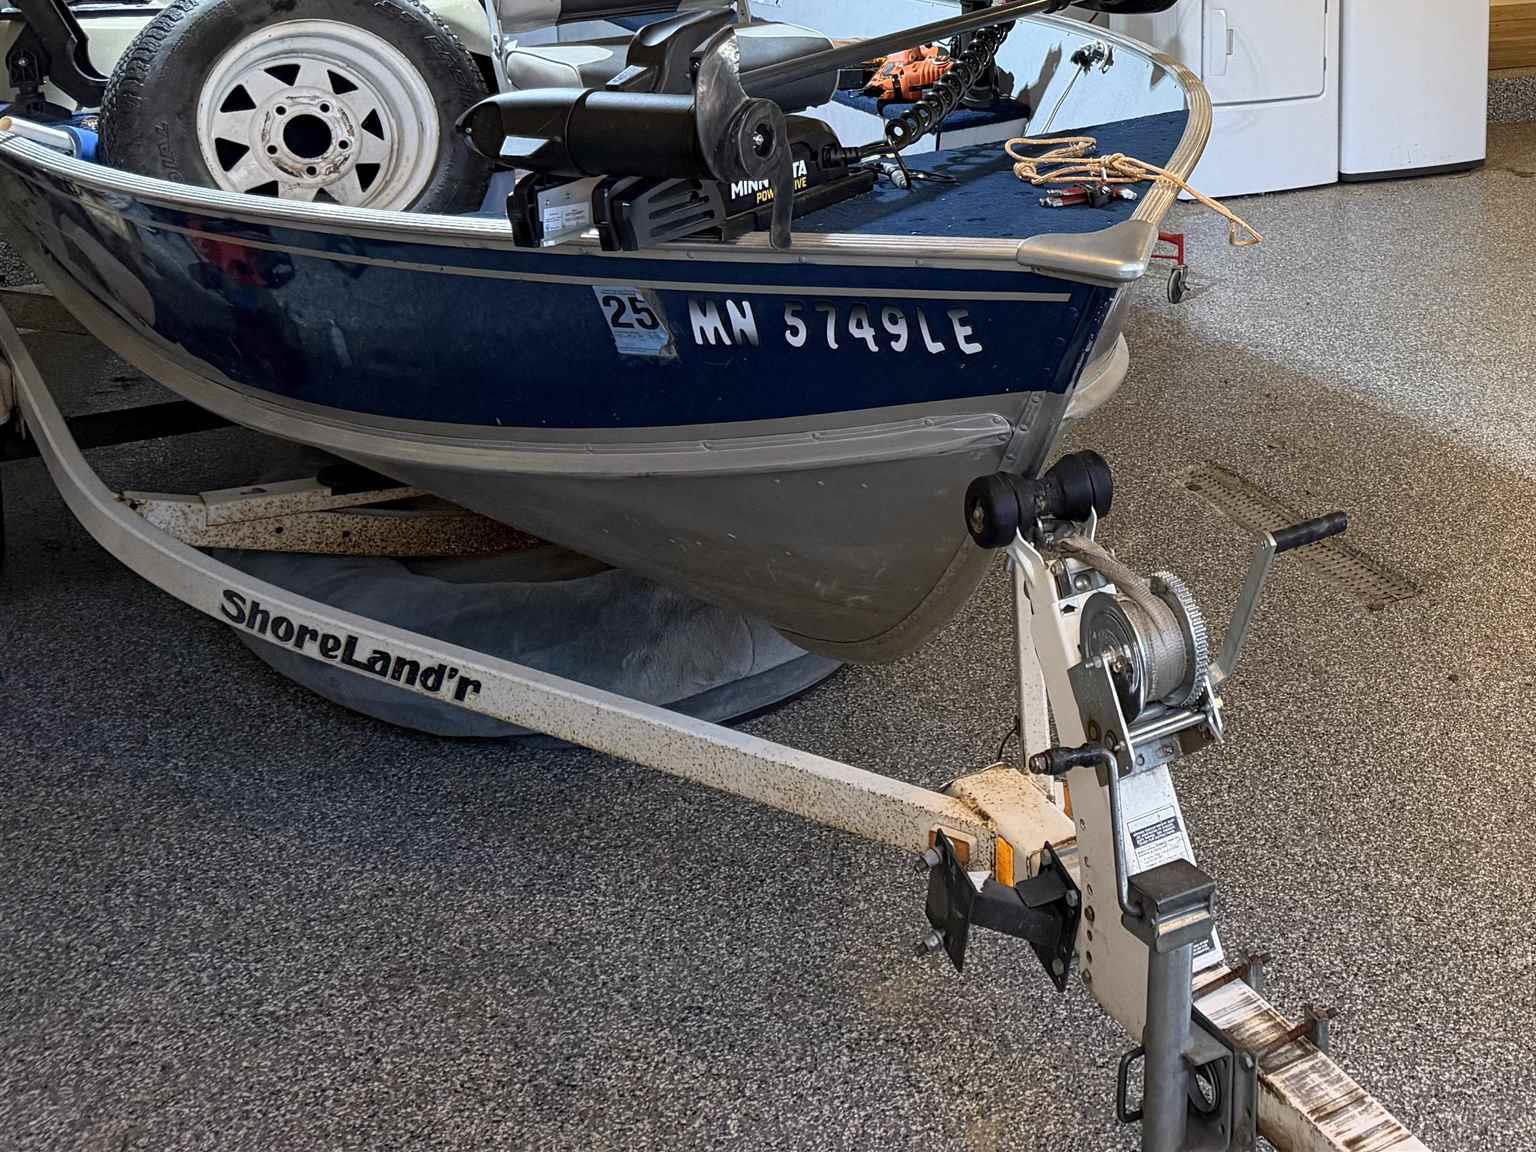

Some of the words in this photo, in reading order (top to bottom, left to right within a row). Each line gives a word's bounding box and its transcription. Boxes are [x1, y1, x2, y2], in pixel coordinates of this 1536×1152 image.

[602, 295, 660, 330] 25
[688, 299, 759, 347] MN
[220, 588, 482, 703] ShoreLand'r
